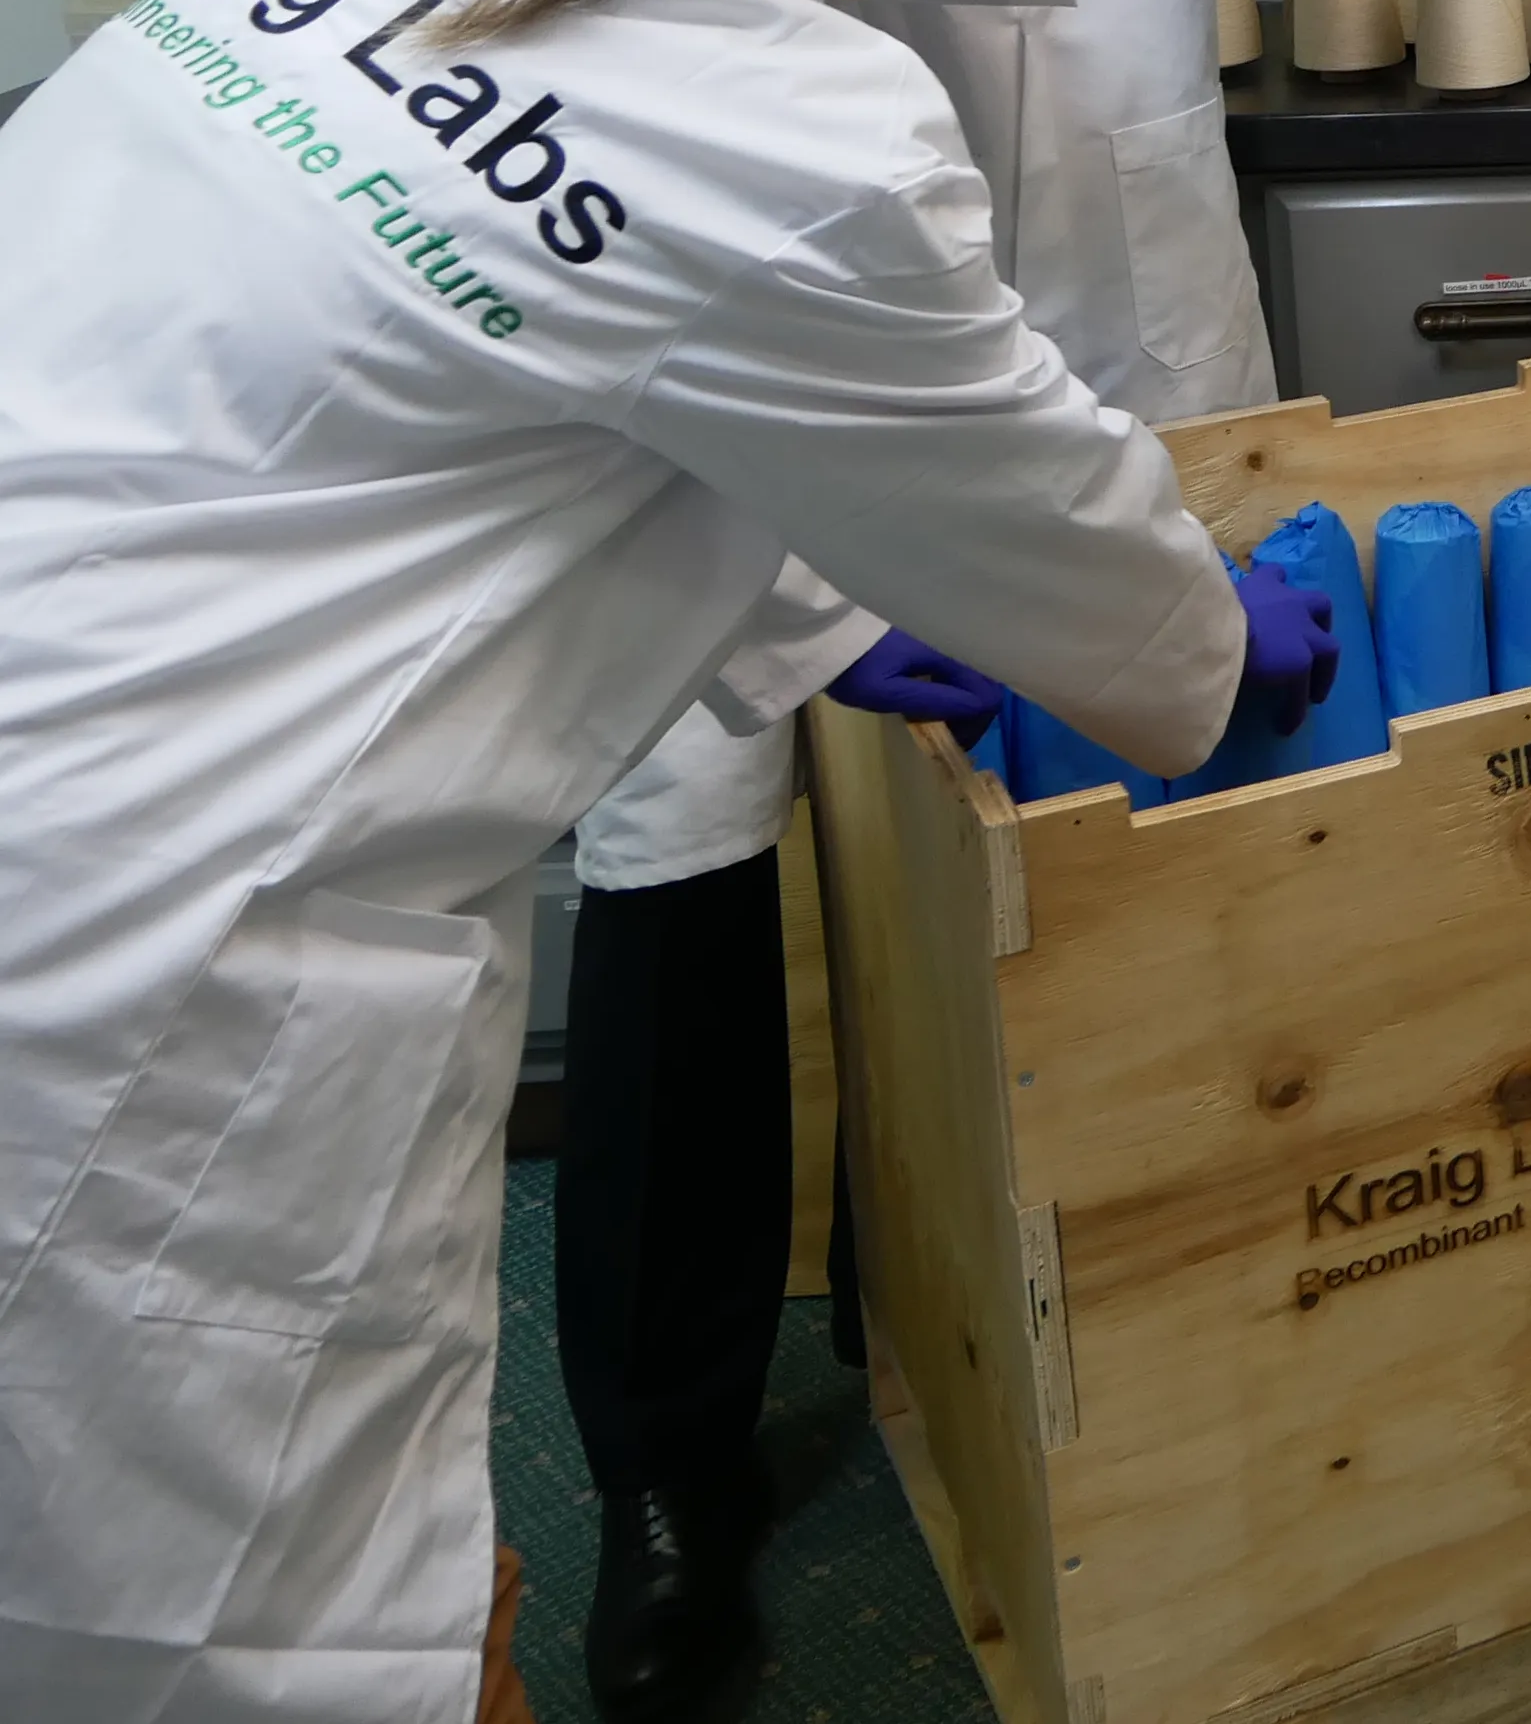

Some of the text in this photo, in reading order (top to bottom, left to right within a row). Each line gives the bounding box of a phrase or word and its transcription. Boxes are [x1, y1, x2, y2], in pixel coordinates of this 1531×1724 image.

[253, 98, 343, 174] the
[336, 169, 524, 340] Future
[1480, 282, 1495, 290] use
[1305, 1146, 1485, 1243] Kraig
[1296, 1202, 1526, 1300] Recombinant
